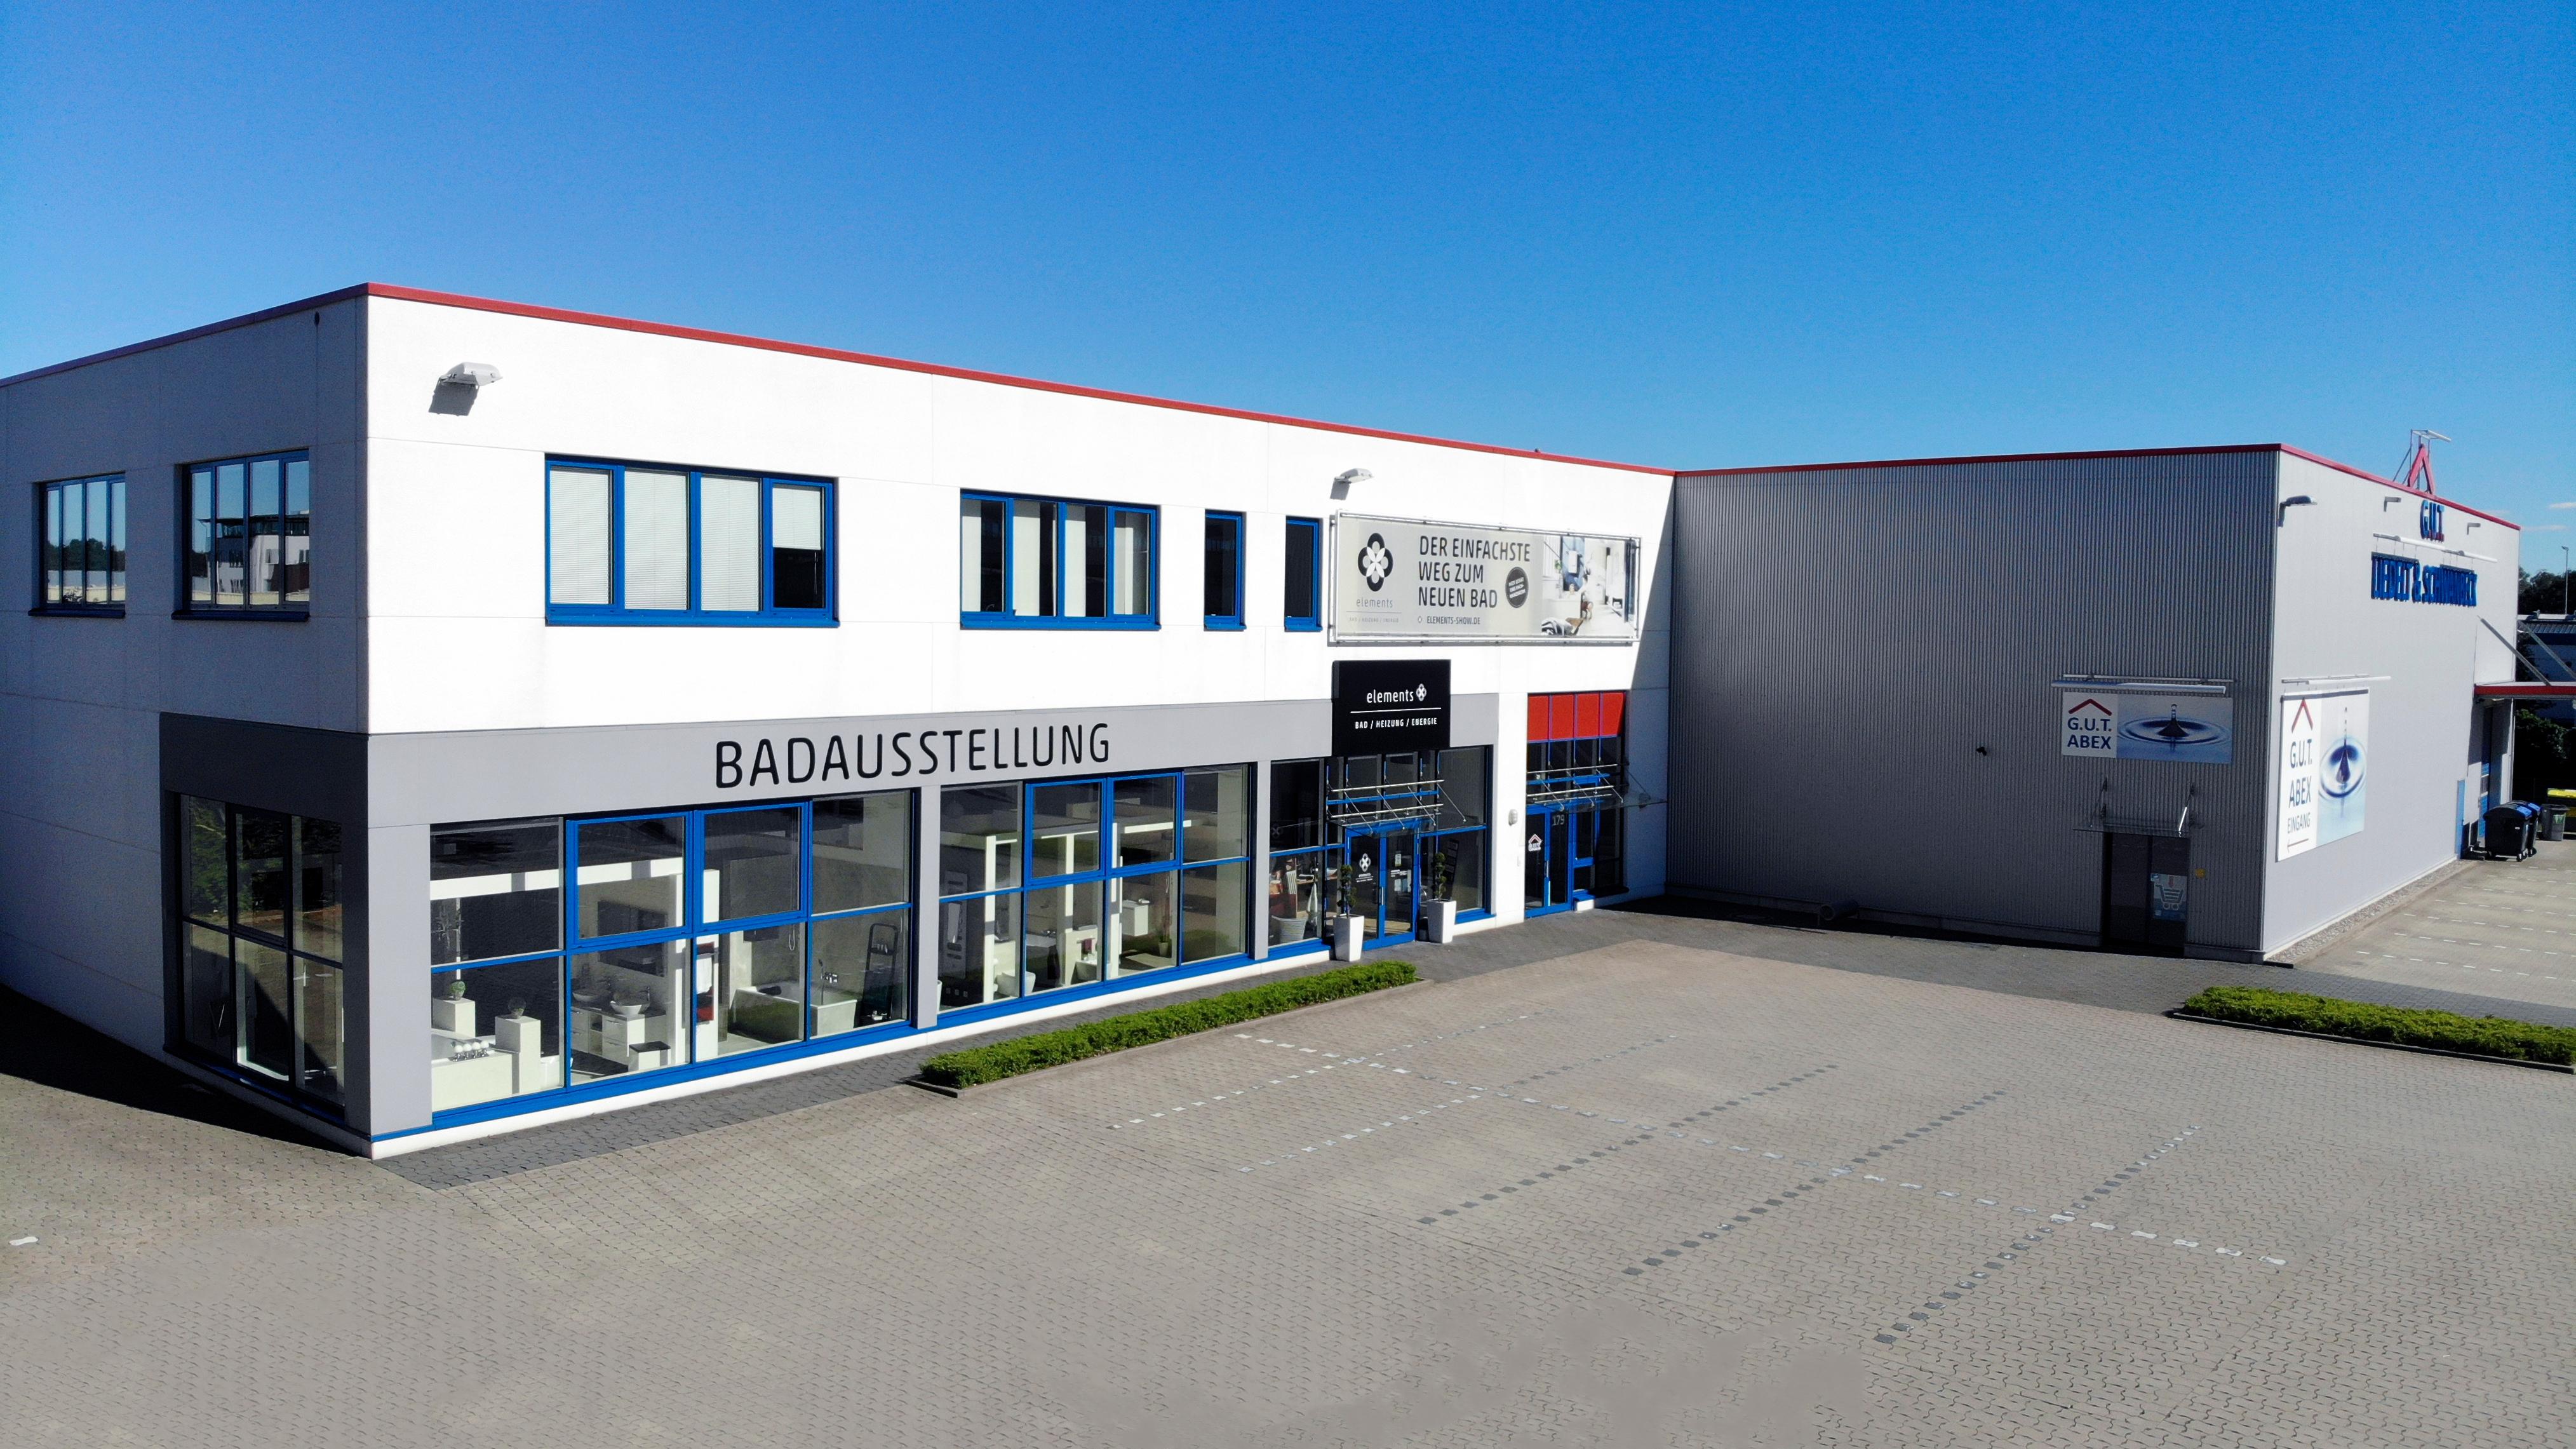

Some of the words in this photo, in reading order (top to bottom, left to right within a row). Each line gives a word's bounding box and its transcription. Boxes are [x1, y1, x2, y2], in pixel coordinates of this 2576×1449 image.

[1419, 536, 1447, 557] DER
[1452, 538, 1531, 562] EINFACHSTE
[1418, 561, 1450, 582] WEG
[1454, 563, 1484, 583] ZUM
[1356, 597, 1393, 608] elements
[1418, 586, 1465, 607] NEUEN
[1470, 589, 1498, 608] BAD
[1426, 616, 1480, 624] ELEMENTS-SHOW.DE
[1366, 689, 1414, 703] elements
[1355, 721, 1368, 729] BAD
[1370, 720, 1374, 729] /
[1376, 719, 1404, 728] HEIZUNG
[1405, 718, 1409, 727] /
[1411, 717, 1437, 726] ENERGIE
[2067, 717, 2112, 732] G.U.T.
[2067, 734, 2112, 750] ABEX
[715, 723, 1110, 789] BADAUSSTELLUNG
[2290, 738, 2312, 769] G.U.T.
[2288, 776, 2312, 809] ABEX
[1552, 814, 1565, 826] 179
[2287, 812, 2311, 834] EINGANG
